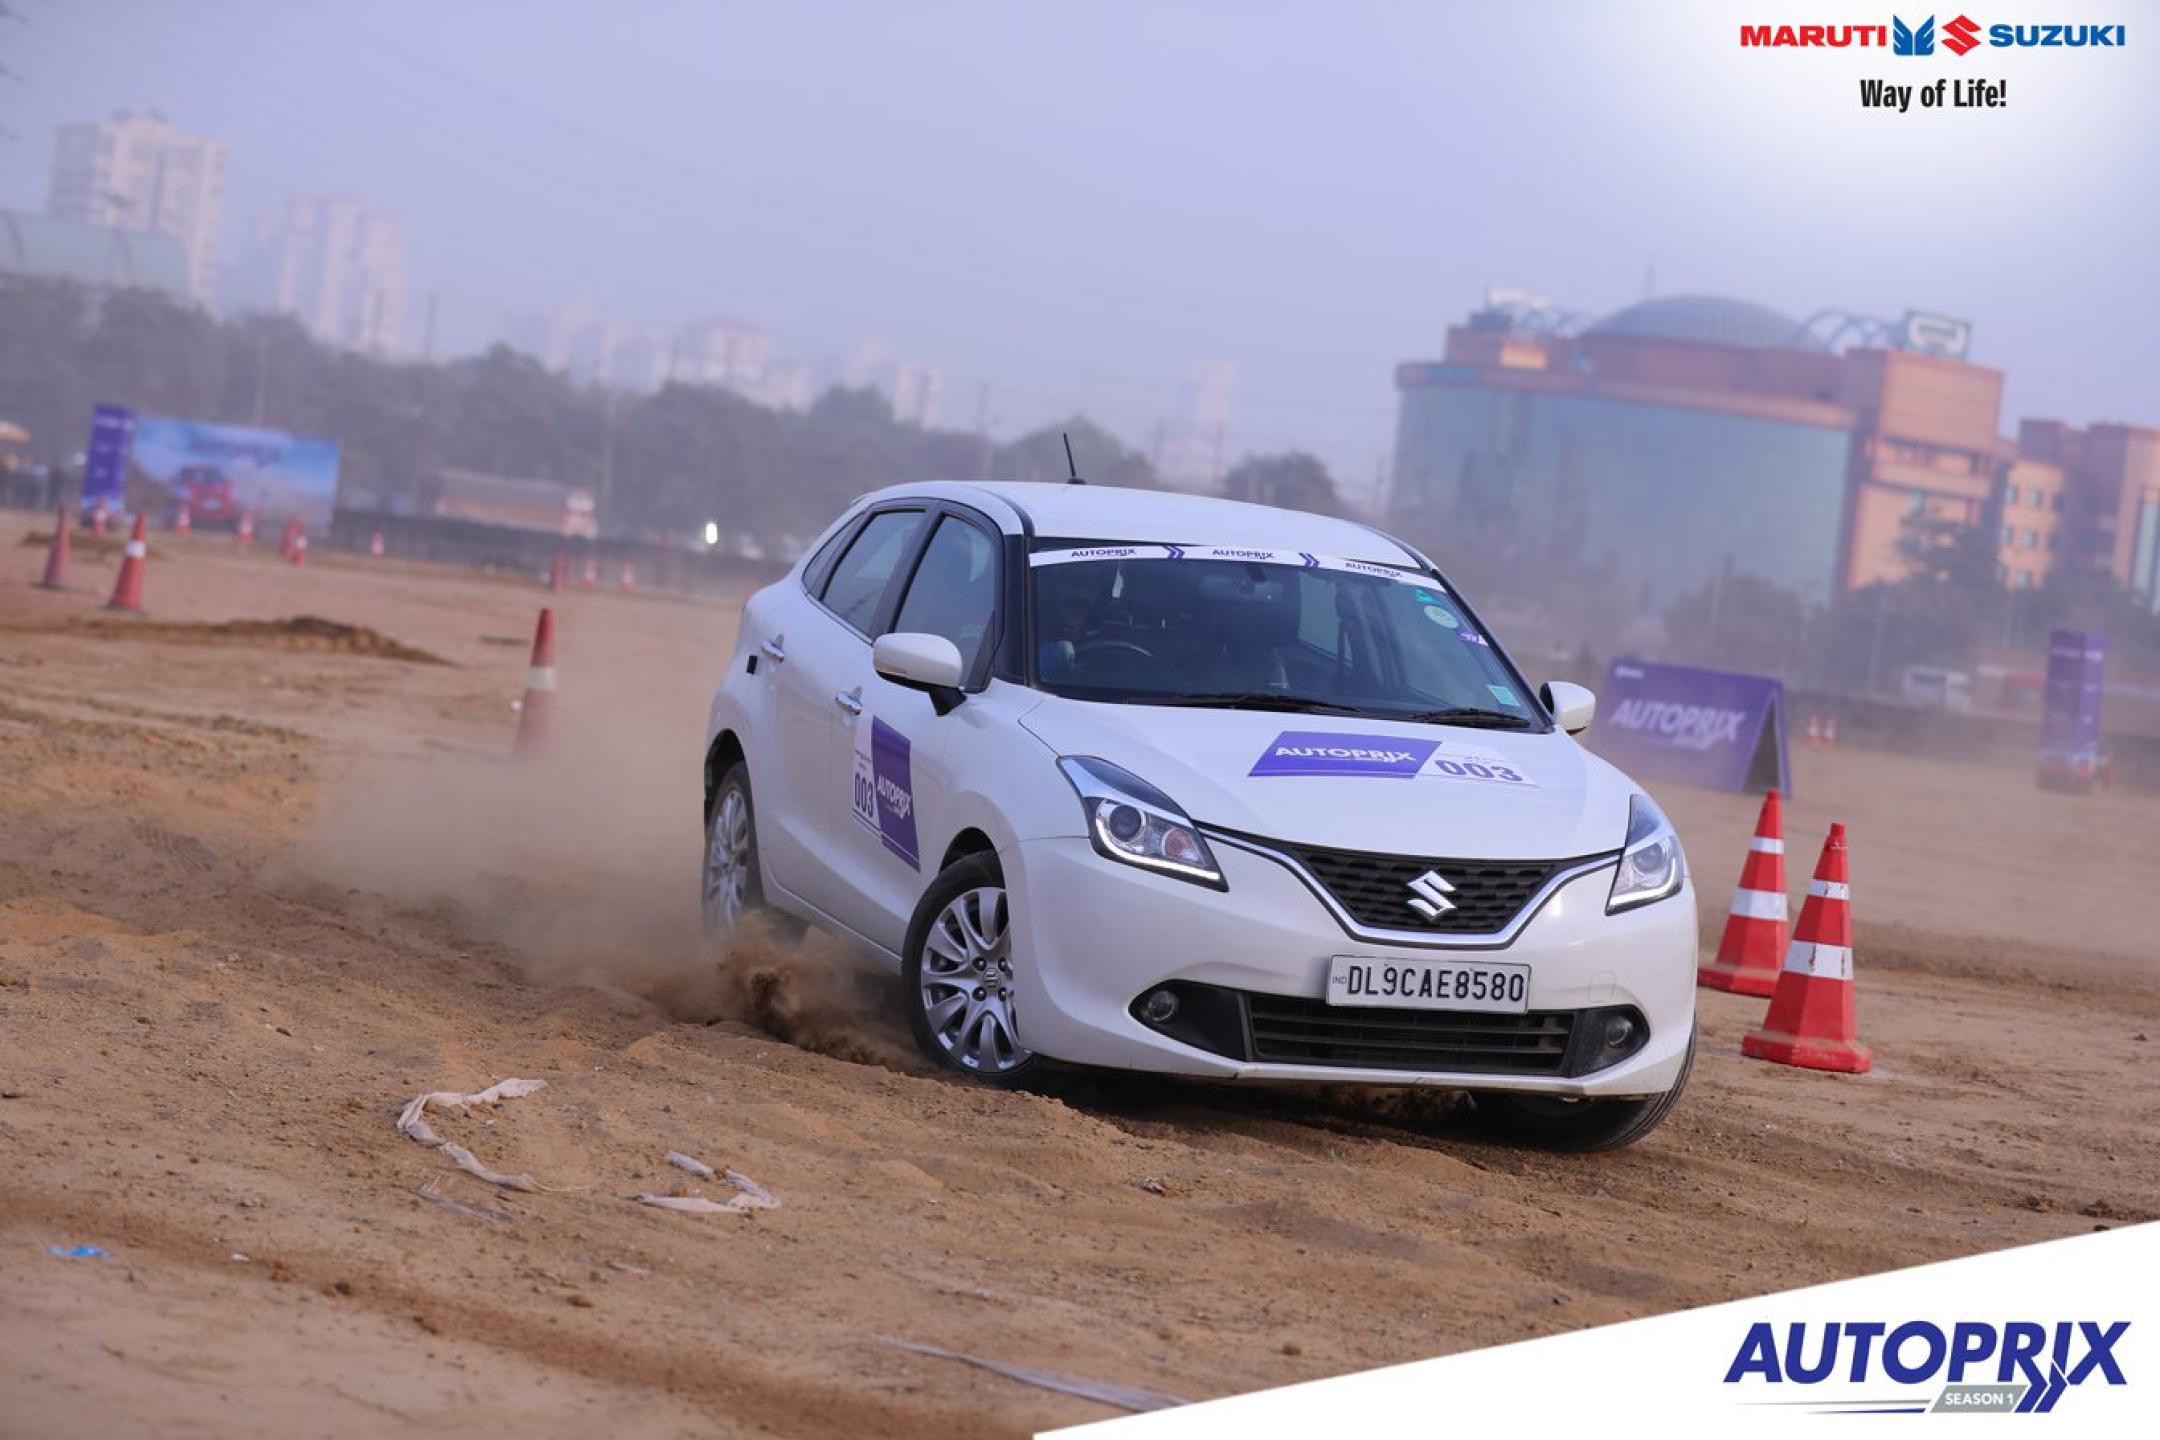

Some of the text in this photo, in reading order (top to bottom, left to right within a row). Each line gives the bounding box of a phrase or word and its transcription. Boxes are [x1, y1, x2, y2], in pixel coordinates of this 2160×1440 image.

[1071, 548, 1137, 558] AUTOPRIX
[1212, 549, 1274, 560] AUTOPRIX
[1608, 699, 1747, 750] AUTOPRIX
[1275, 747, 1417, 763] AUTOPRIX
[1434, 759, 1523, 782] 003
[854, 772, 874, 819] 003
[1347, 965, 1525, 1002] DL9CAE8580
